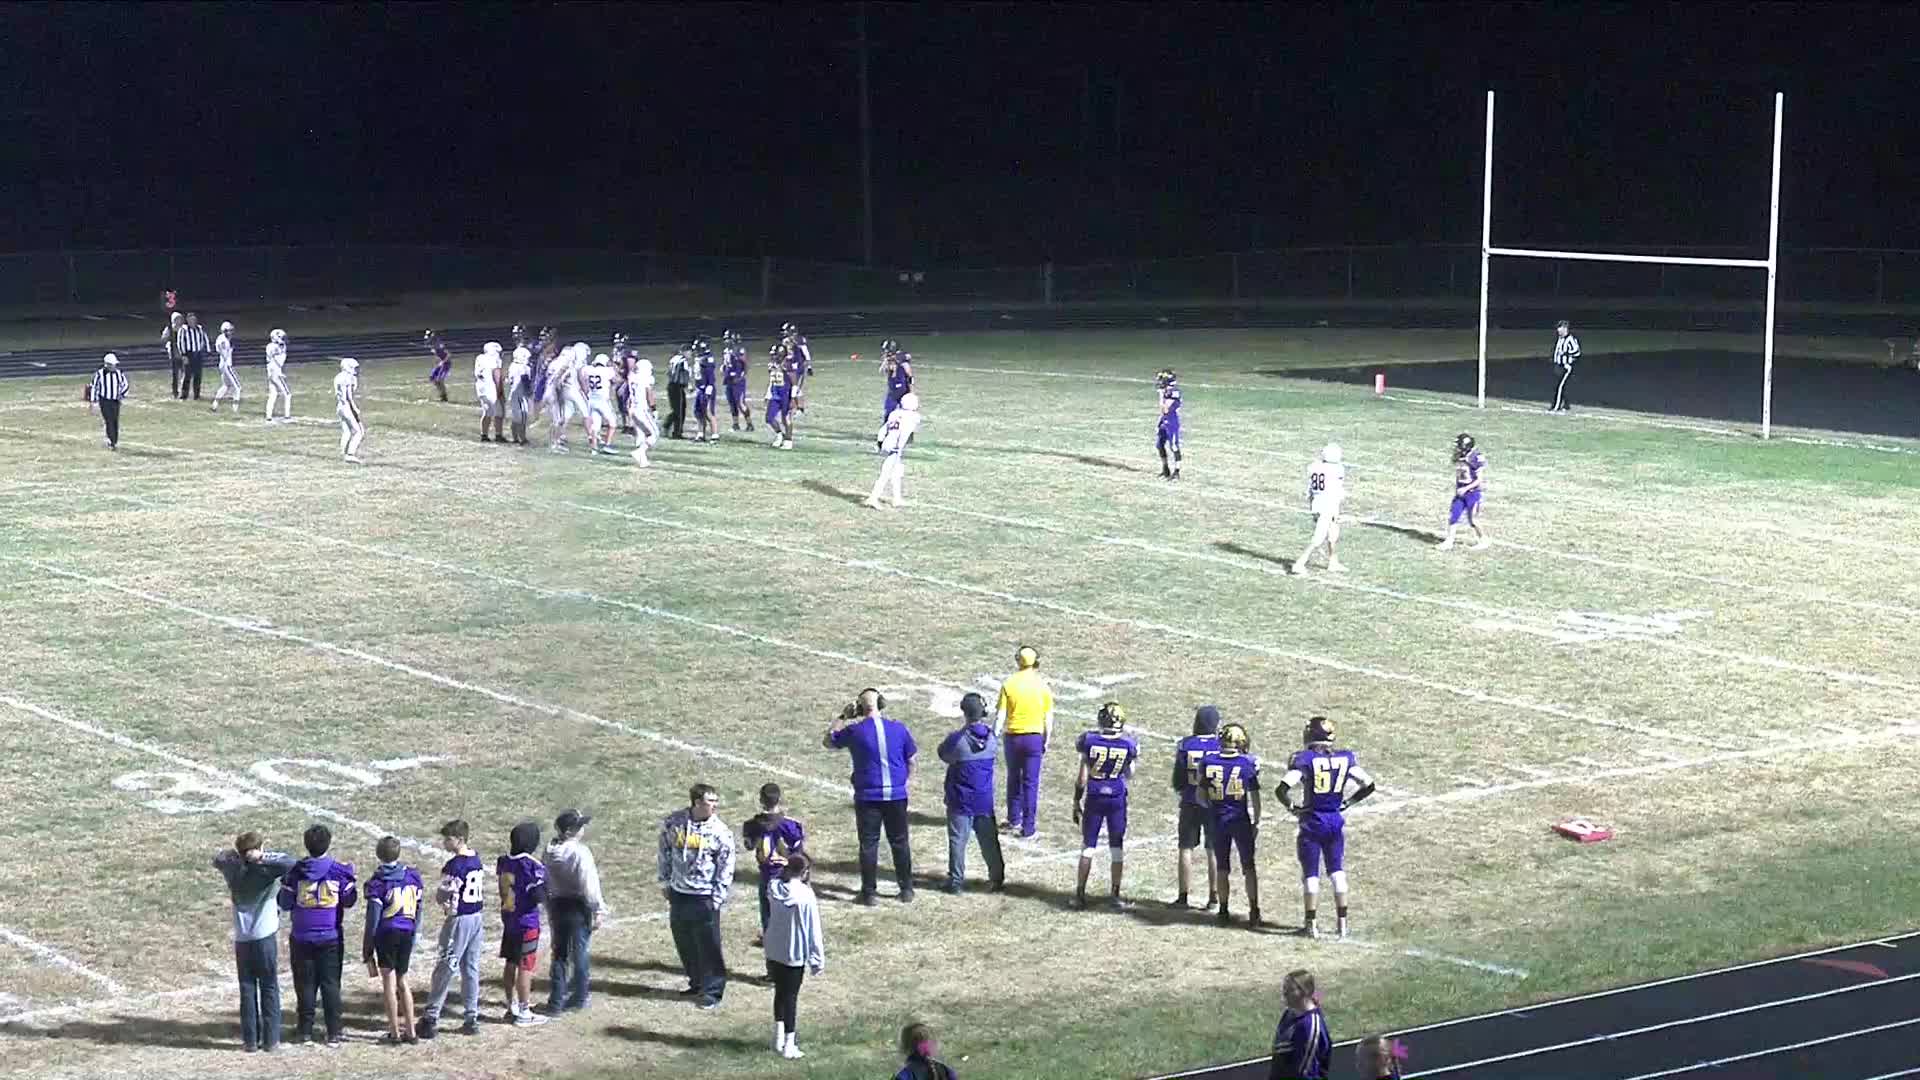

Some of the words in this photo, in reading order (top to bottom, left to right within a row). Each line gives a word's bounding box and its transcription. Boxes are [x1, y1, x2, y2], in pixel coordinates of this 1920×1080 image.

[1311, 472, 1326, 491] 88
[1205, 765, 1245, 800] 34
[1312, 757, 1349, 793] 67
